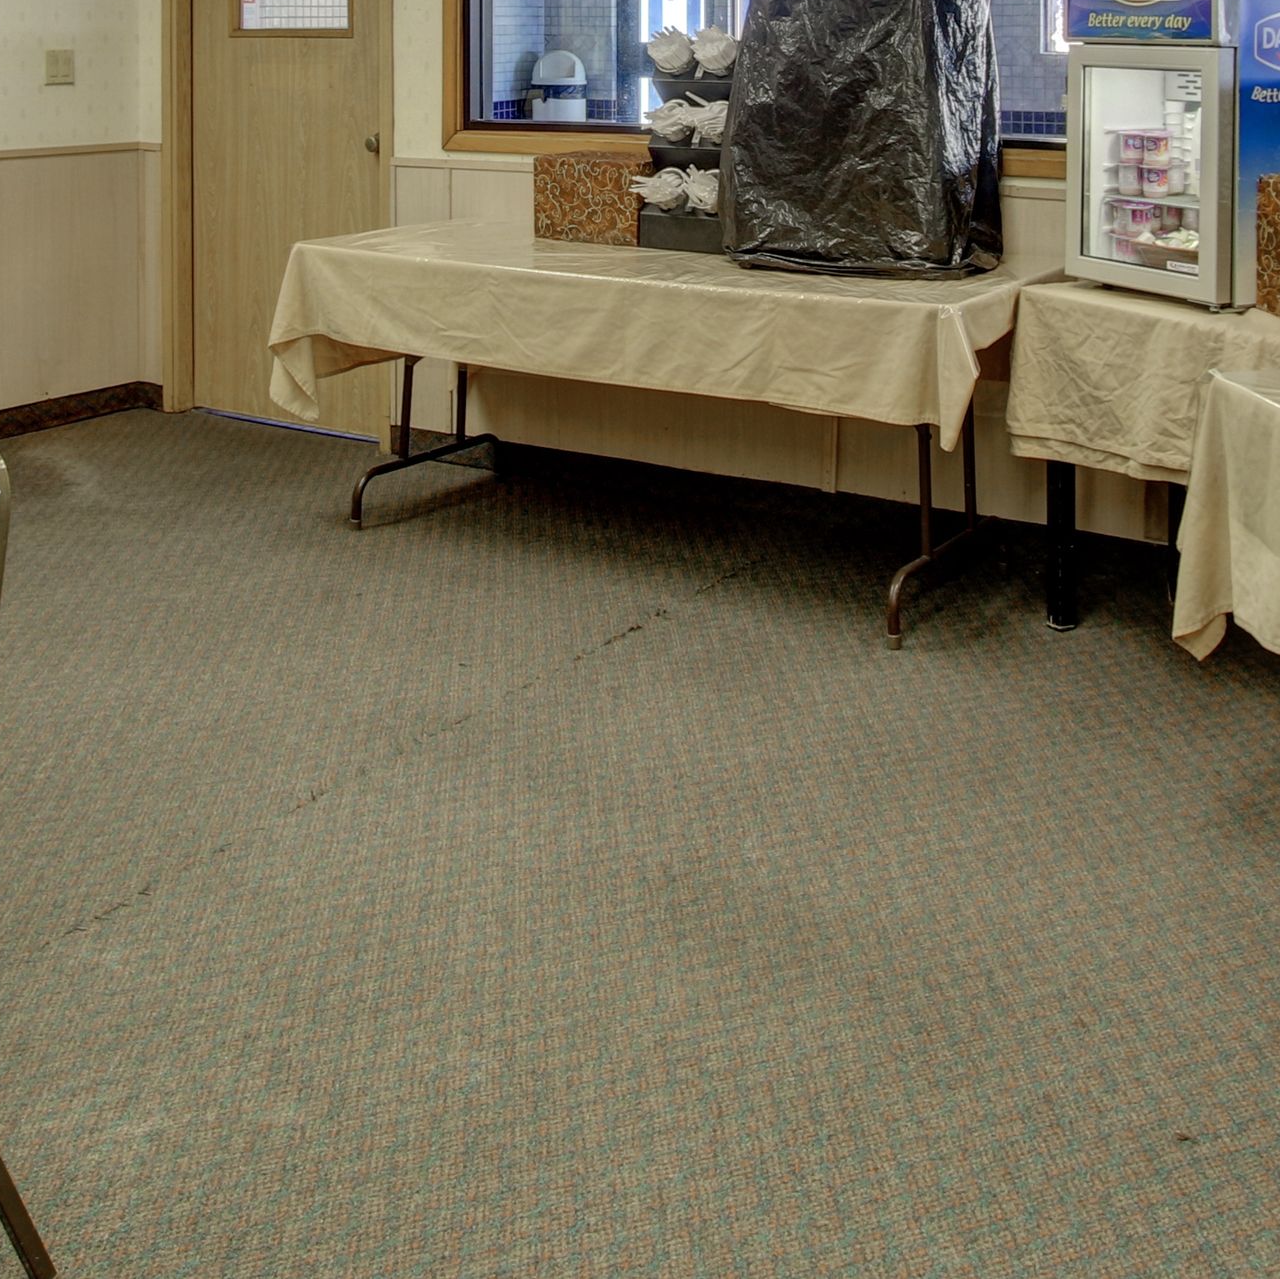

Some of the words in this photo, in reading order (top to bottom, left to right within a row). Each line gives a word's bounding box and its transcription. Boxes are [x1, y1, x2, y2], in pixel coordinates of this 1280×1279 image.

[1088, 12, 1126, 27] Better
[1127, 15, 1163, 30] every
[1165, 14, 1192, 31] day
